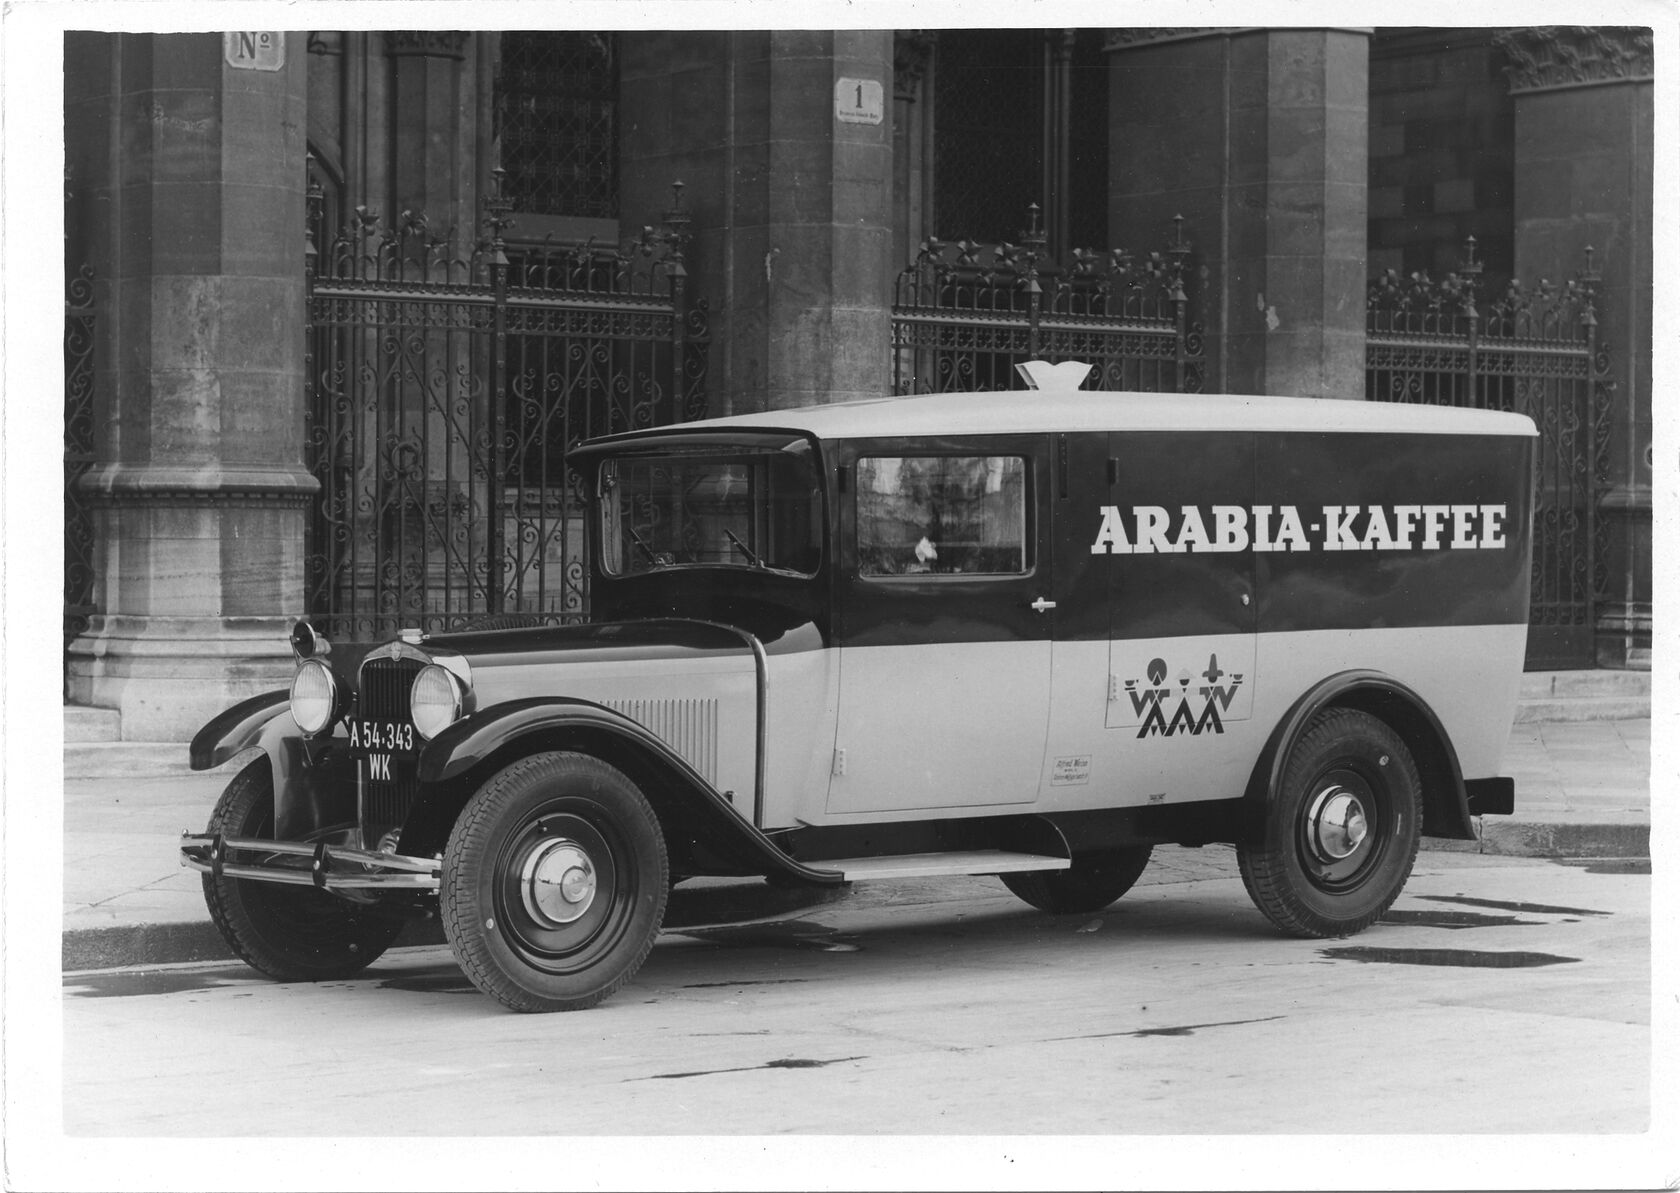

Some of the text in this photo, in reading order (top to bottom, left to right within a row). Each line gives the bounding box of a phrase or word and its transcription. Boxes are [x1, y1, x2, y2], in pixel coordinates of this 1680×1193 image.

[855, 84, 864, 109] 1
[1091, 504, 1507, 555] ARABIA-KAFFEE
[350, 721, 360, 748] A
[369, 753, 391, 781] WK
